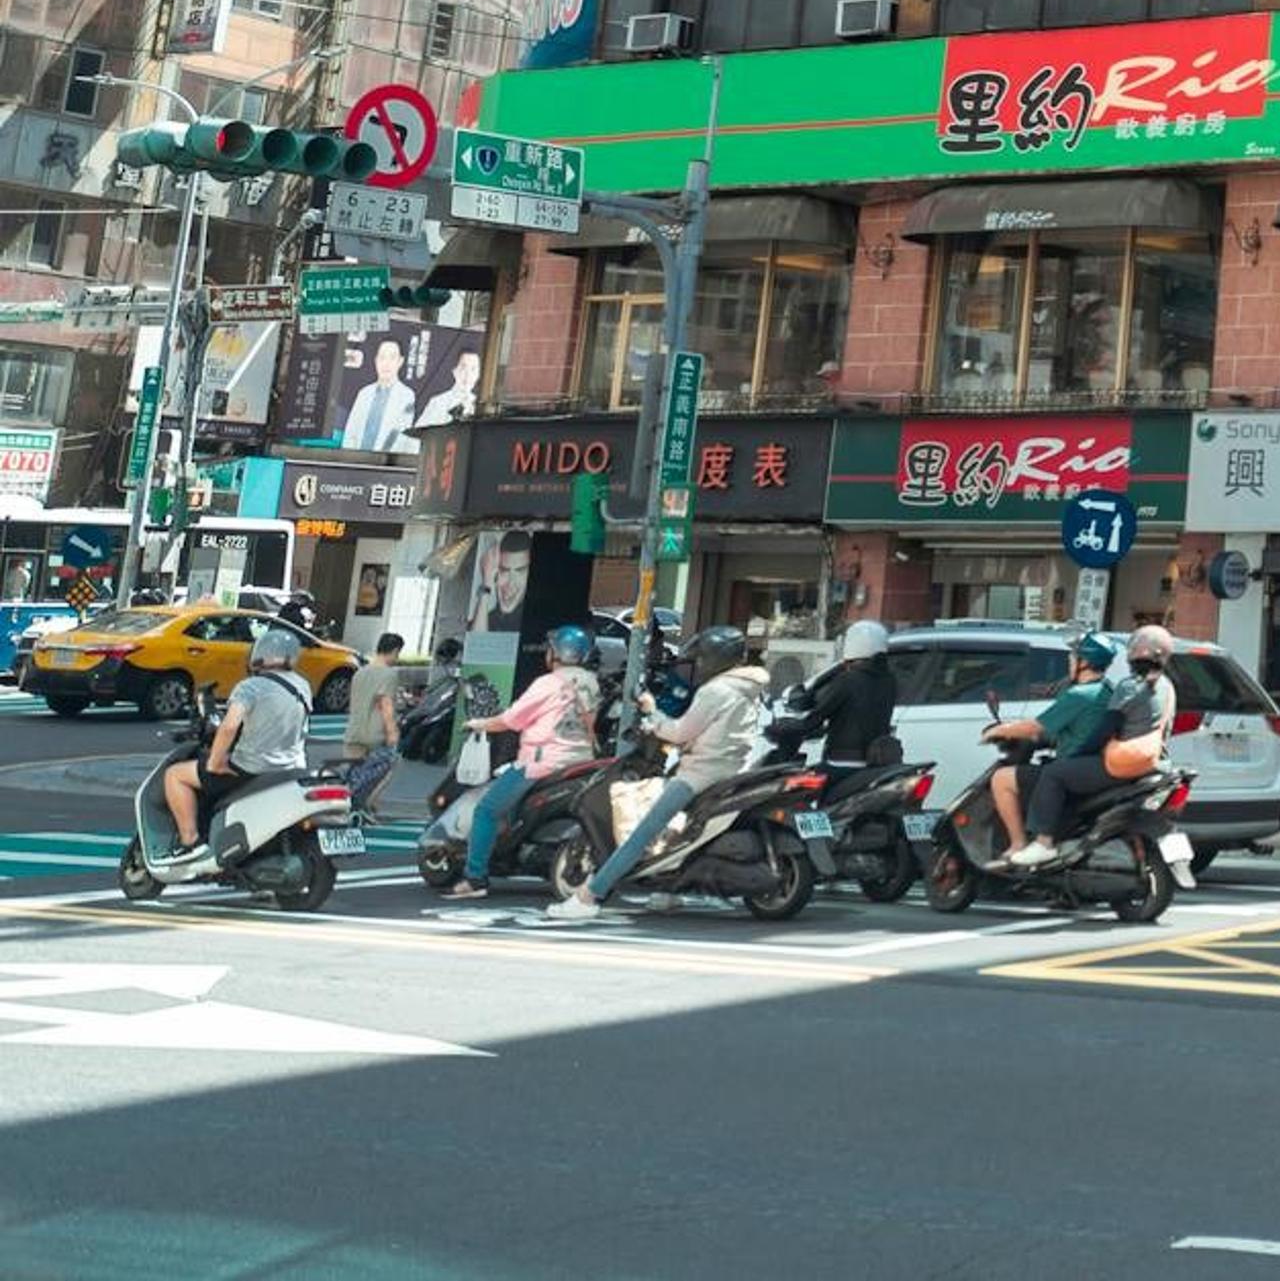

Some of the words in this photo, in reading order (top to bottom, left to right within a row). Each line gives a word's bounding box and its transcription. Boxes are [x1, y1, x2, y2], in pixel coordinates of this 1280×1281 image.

[939, 63, 1097, 156] 里約
[504, 140, 563, 170] 重新路
[669, 371, 694, 460] 正義南路
[513, 441, 610, 474] MIDO
[899, 440, 1010, 508] 里約
[1007, 437, 1141, 487] Rio
